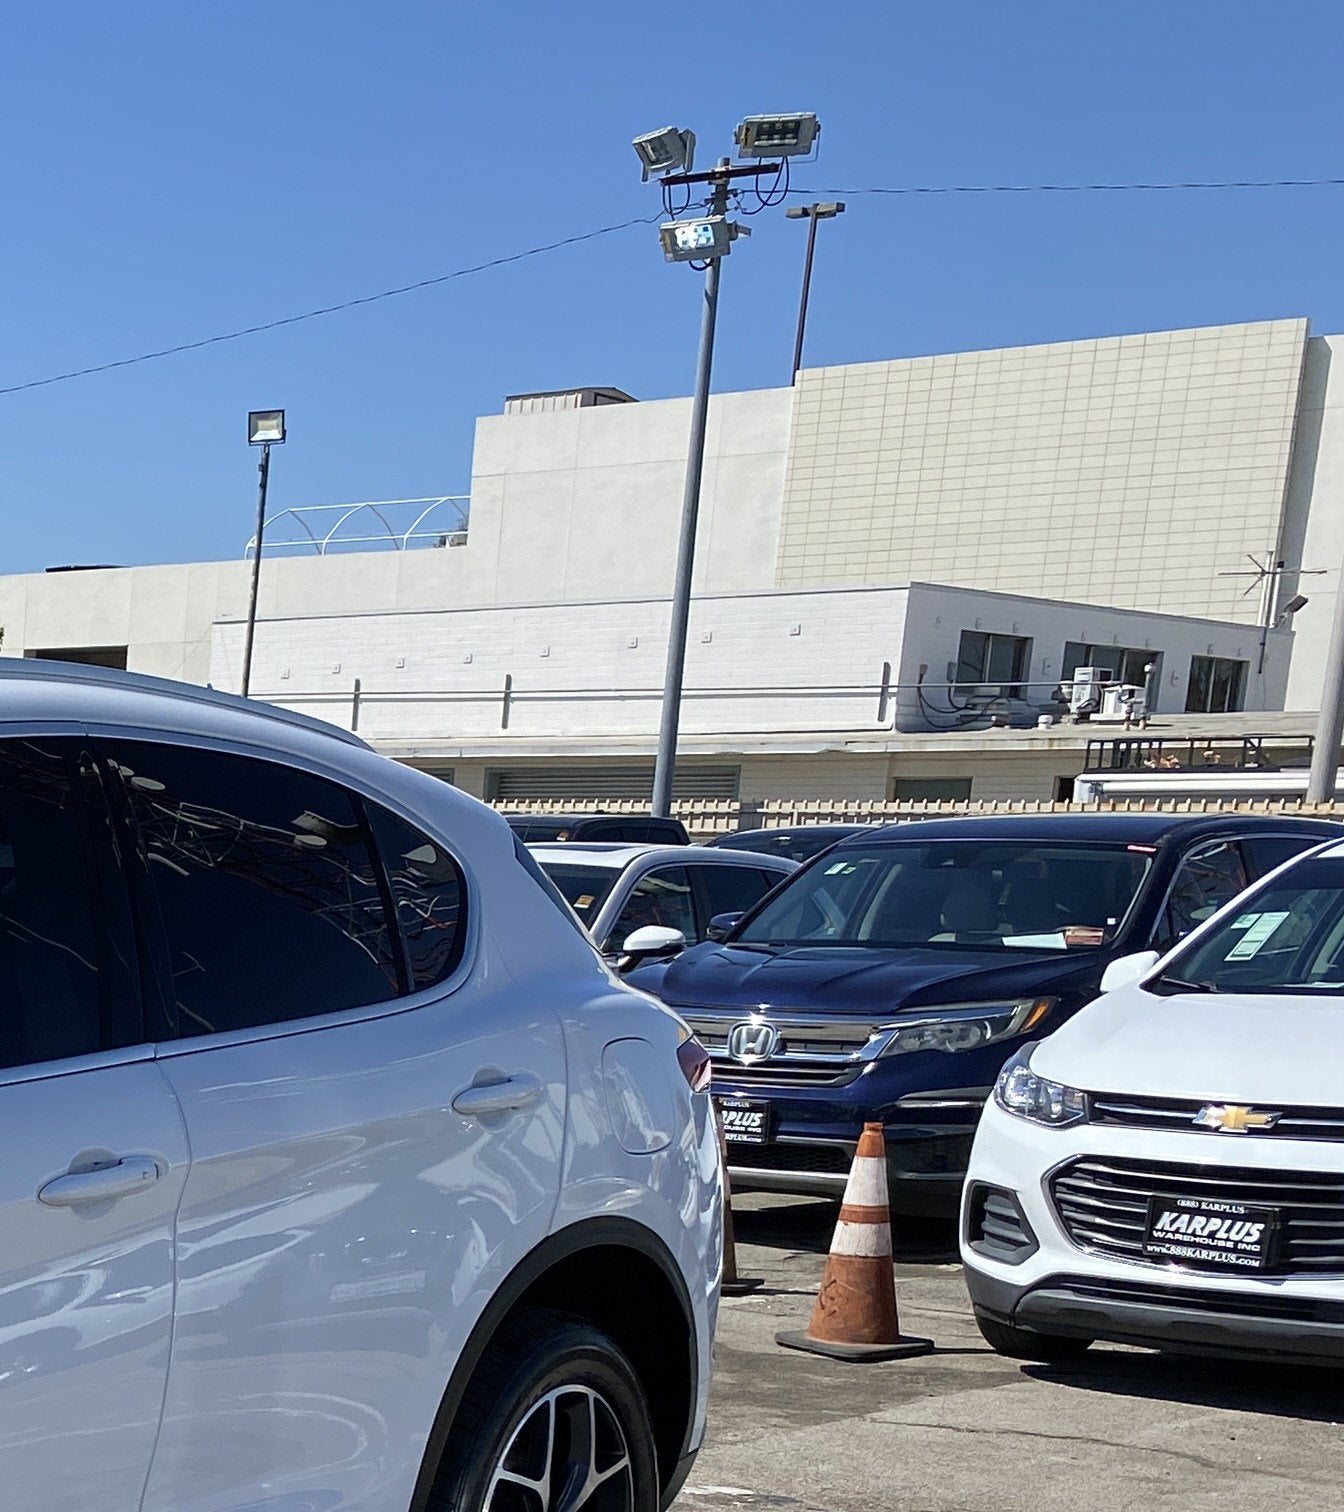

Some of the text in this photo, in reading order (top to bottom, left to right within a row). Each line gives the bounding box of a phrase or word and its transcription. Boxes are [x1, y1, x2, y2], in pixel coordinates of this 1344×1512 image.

[1201, 1201, 1245, 1214] KARPLUS
[1154, 1211, 1265, 1243] KARPLUS
[1152, 1230, 1261, 1252] WAREHOUSE INC
